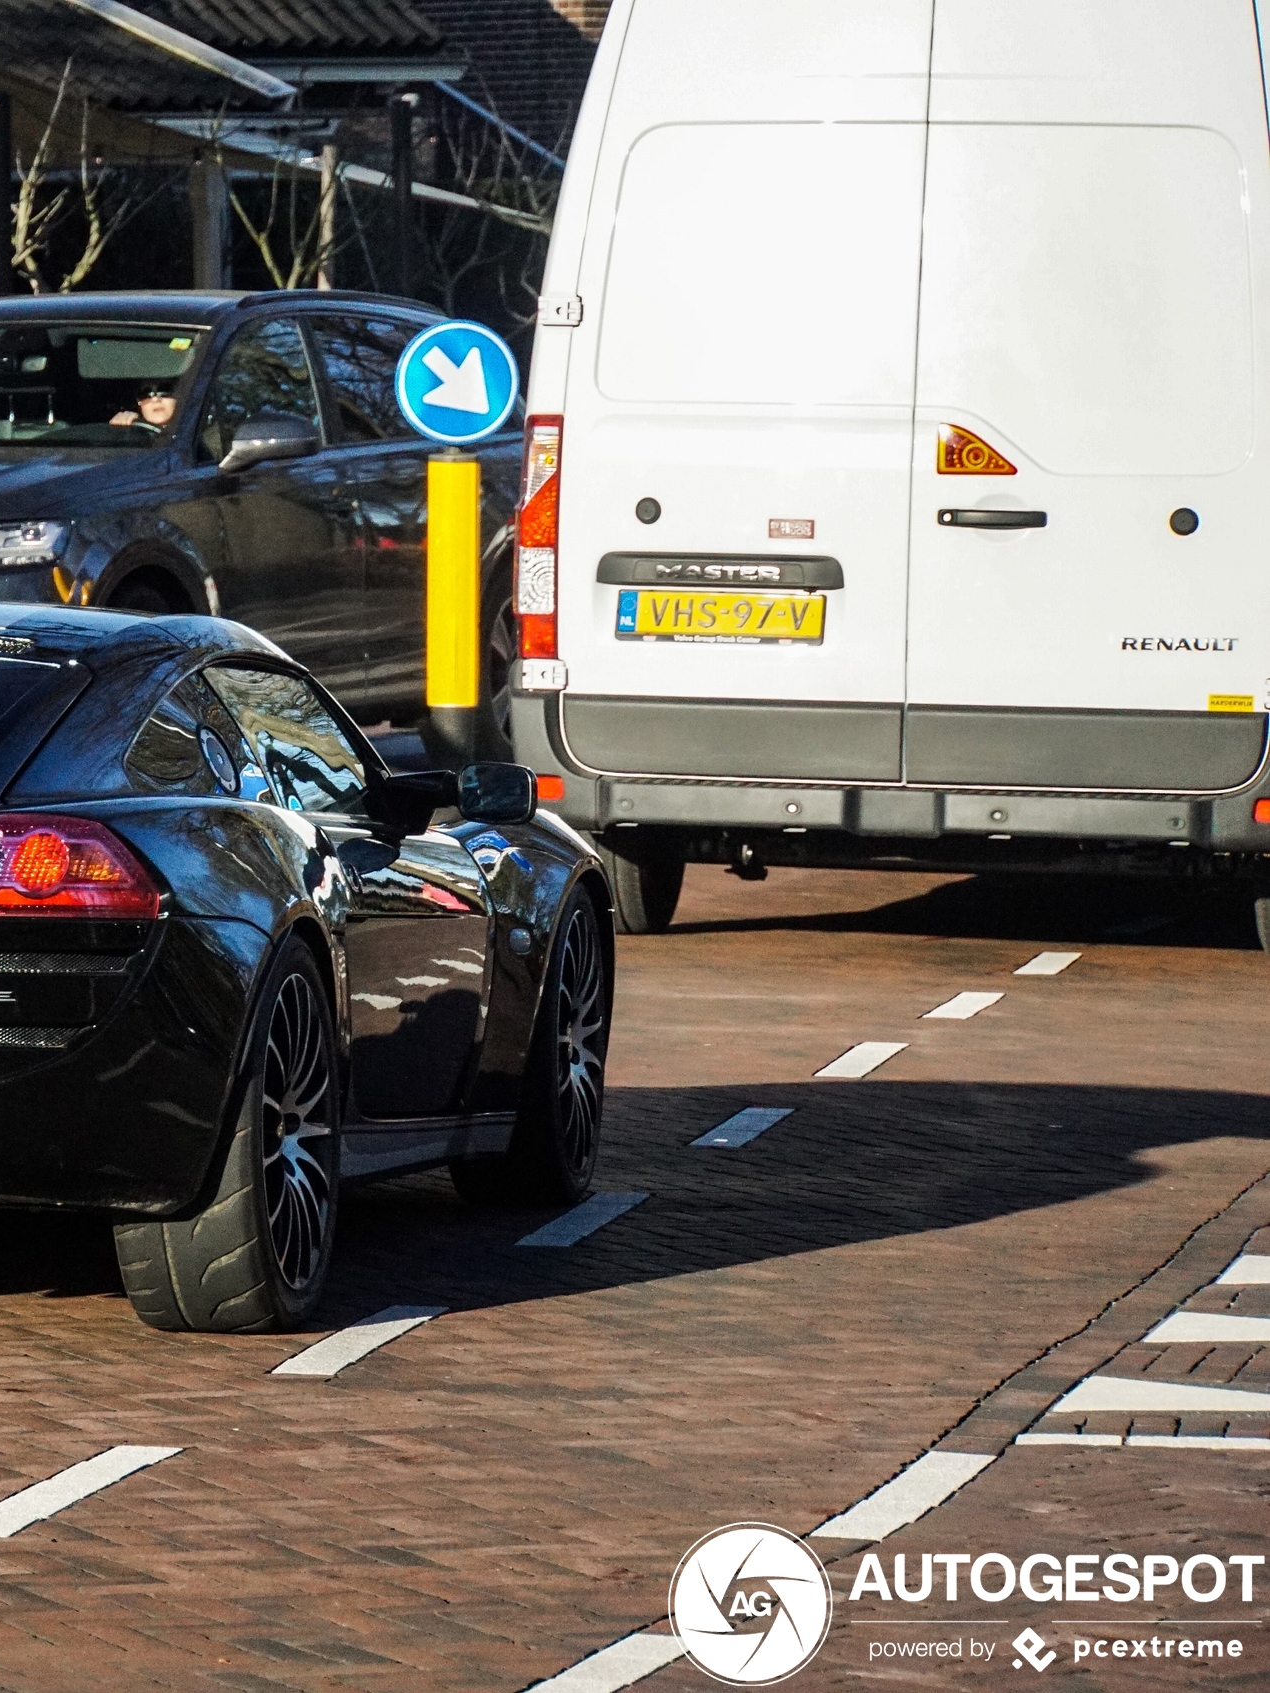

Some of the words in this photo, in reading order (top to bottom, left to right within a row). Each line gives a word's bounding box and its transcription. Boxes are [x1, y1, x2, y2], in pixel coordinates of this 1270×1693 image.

[656, 564, 780, 581] MASTER
[620, 616, 634, 626] NL
[651, 598, 809, 631] VHS-97-V
[1121, 637, 1239, 651] RENAULT
